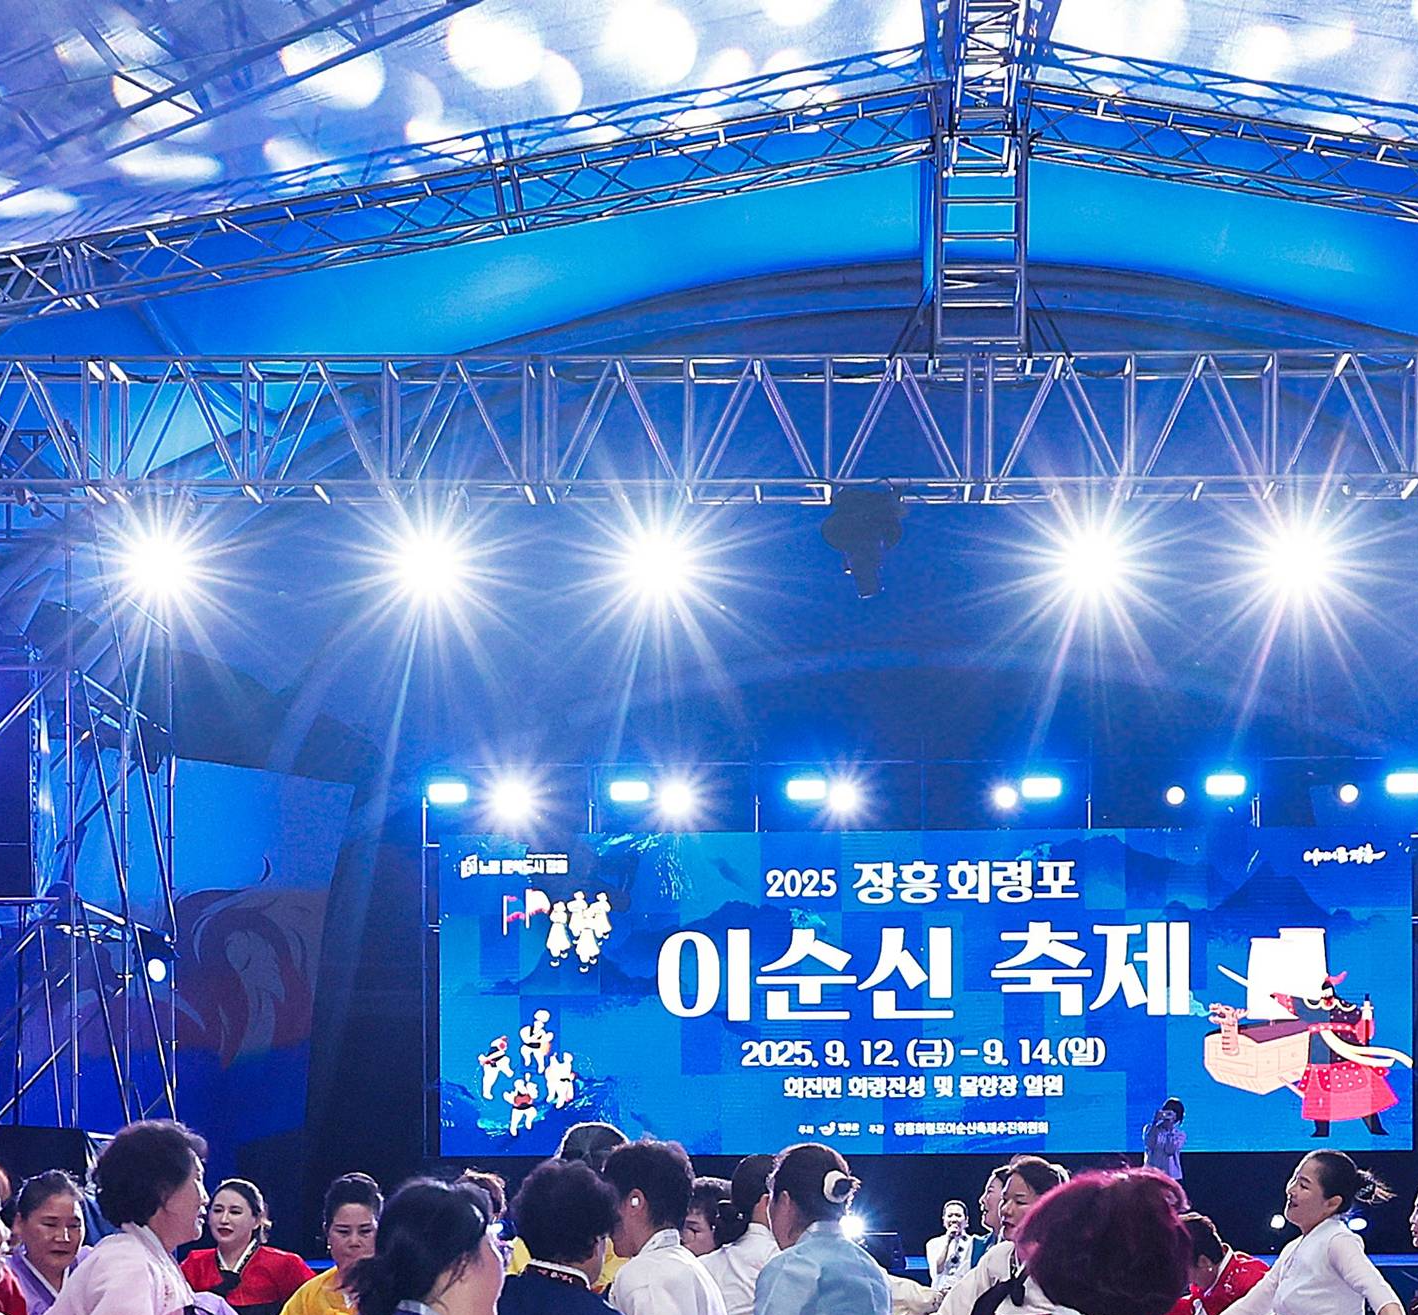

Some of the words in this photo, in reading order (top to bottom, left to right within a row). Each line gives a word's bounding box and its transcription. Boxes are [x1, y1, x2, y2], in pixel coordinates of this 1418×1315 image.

[767, 869, 838, 898] 2025
[853, 861, 941, 903] 장흥
[947, 861, 1079, 902] 회령포
[657, 928, 954, 1021] 이순신
[990, 922, 1191, 1016] 축제
[741, 1041, 818, 1068] 2025.
[825, 1041, 850, 1068] 9.
[783, 1076, 842, 1099] 회진면
[847, 1076, 926, 1099] 회령진성
[933, 1075, 954, 1098] 및
[958, 1075, 1019, 1098] 물양장
[1023, 1074, 1064, 1097] 일원
